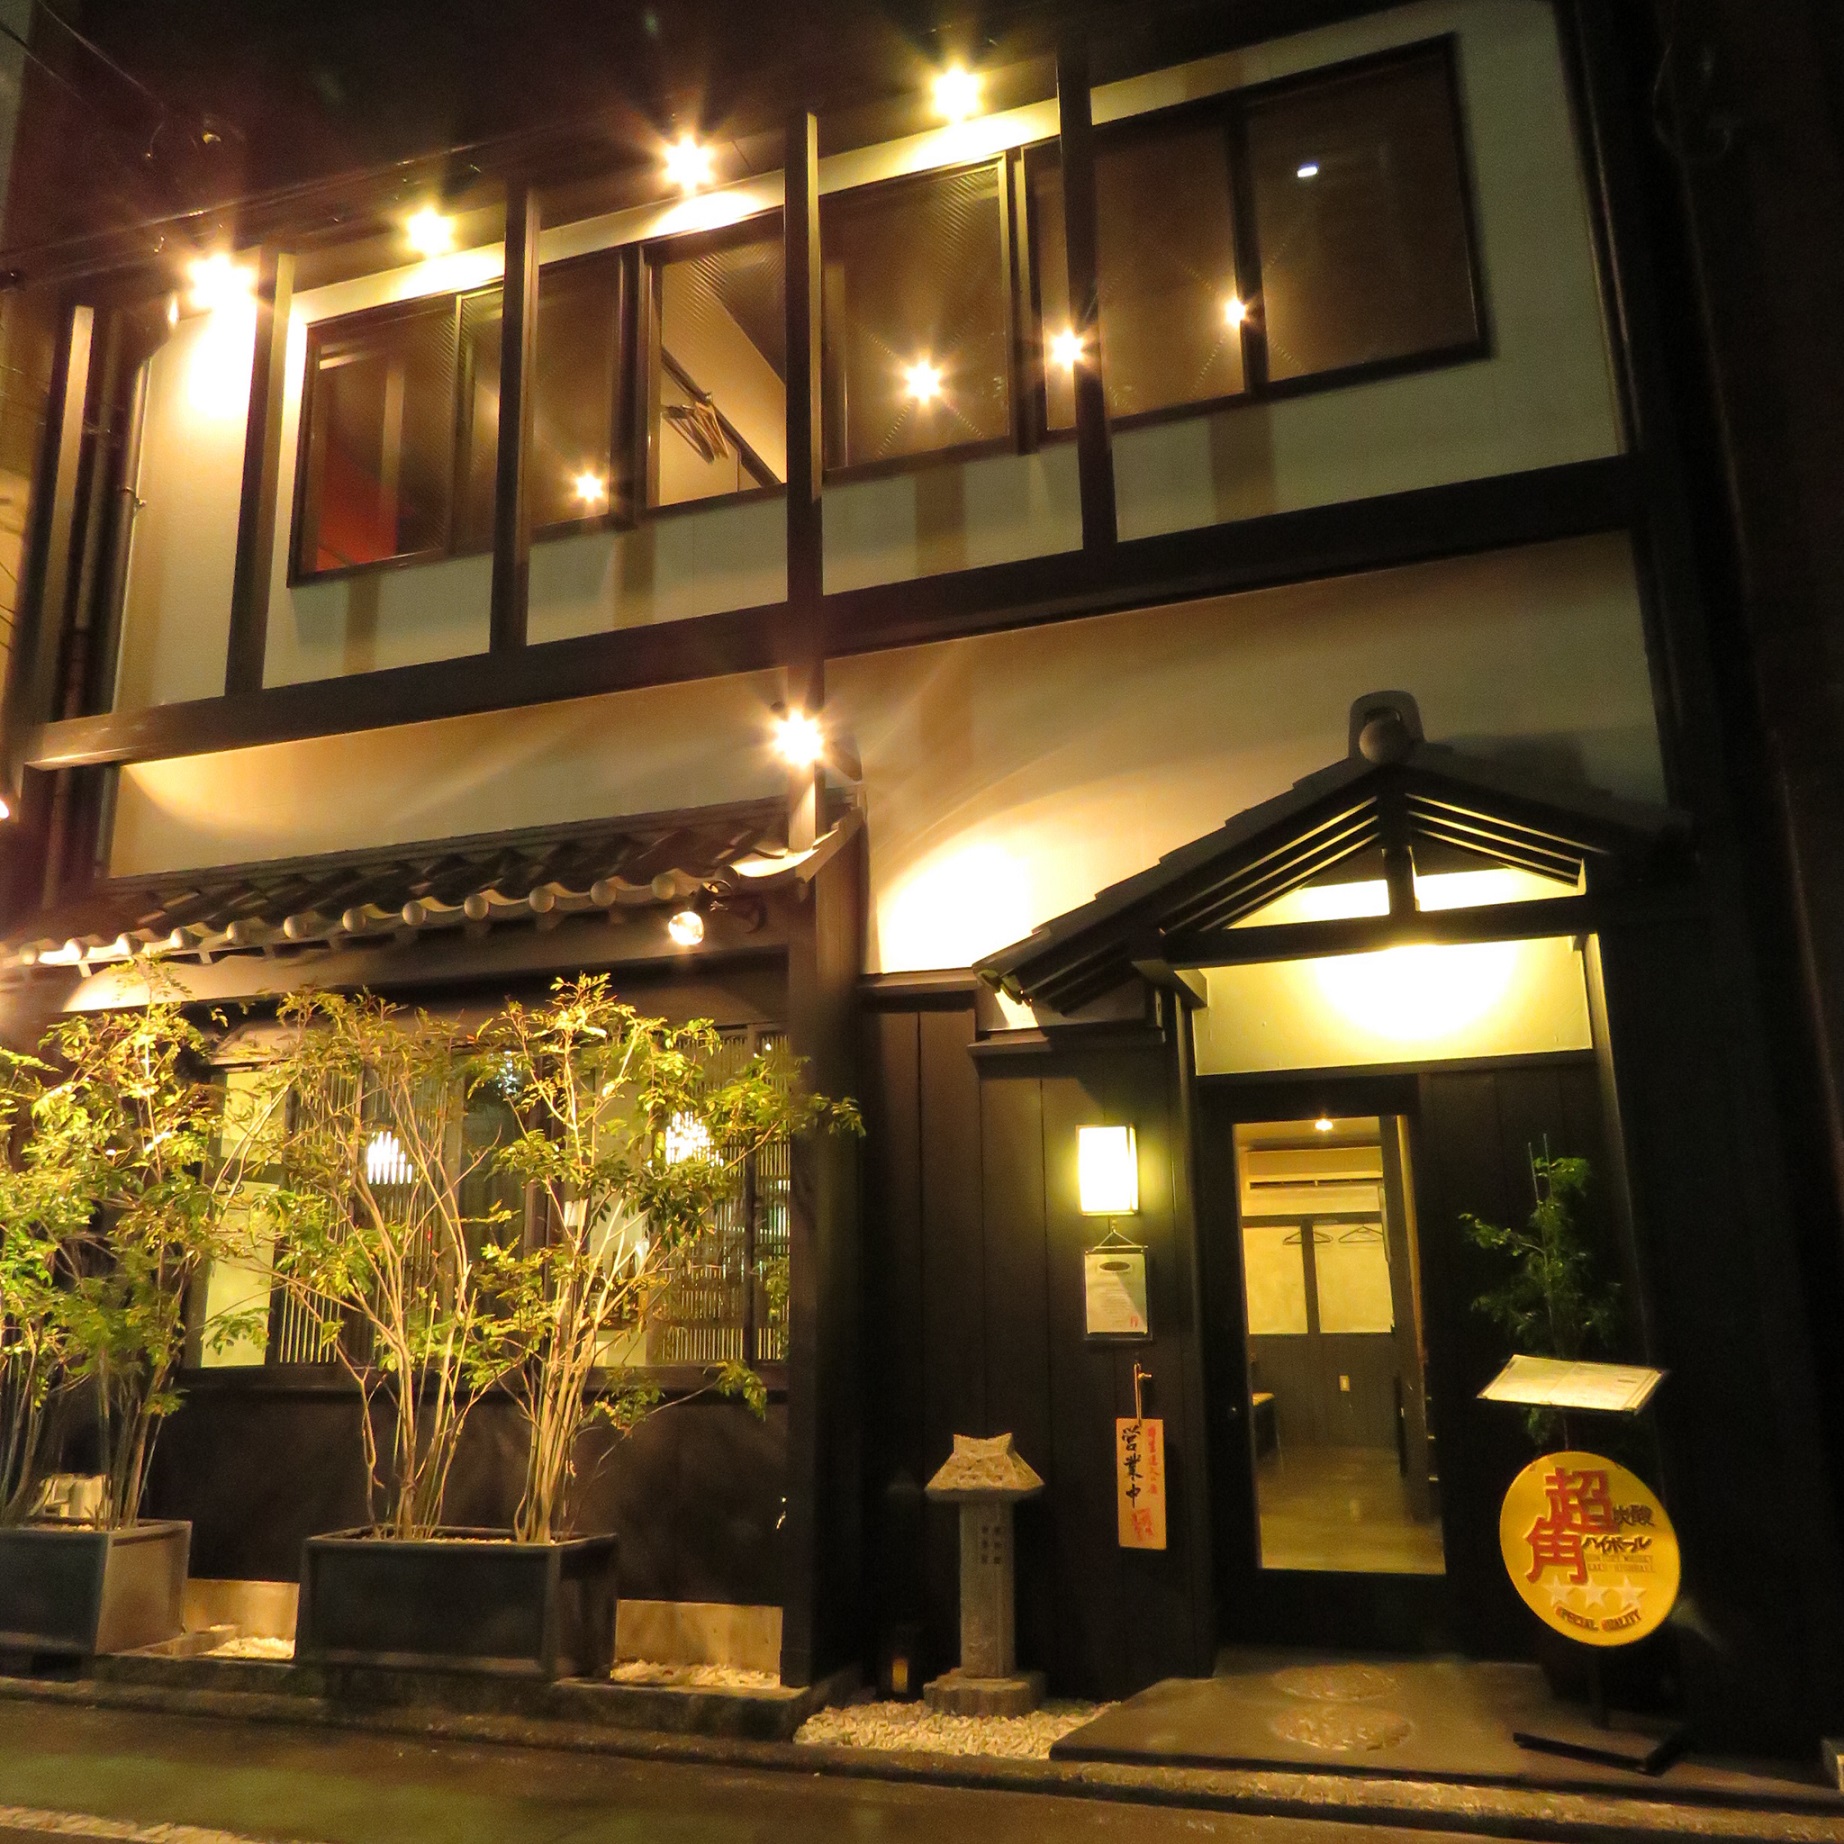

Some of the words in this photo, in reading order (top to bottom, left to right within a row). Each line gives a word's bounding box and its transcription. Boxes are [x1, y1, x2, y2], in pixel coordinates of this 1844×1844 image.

[1122, 1423, 1143, 1508] 営業中
[1555, 1606, 1599, 1631] SPECIAL
[1602, 1609, 1642, 1632] QUALITY
